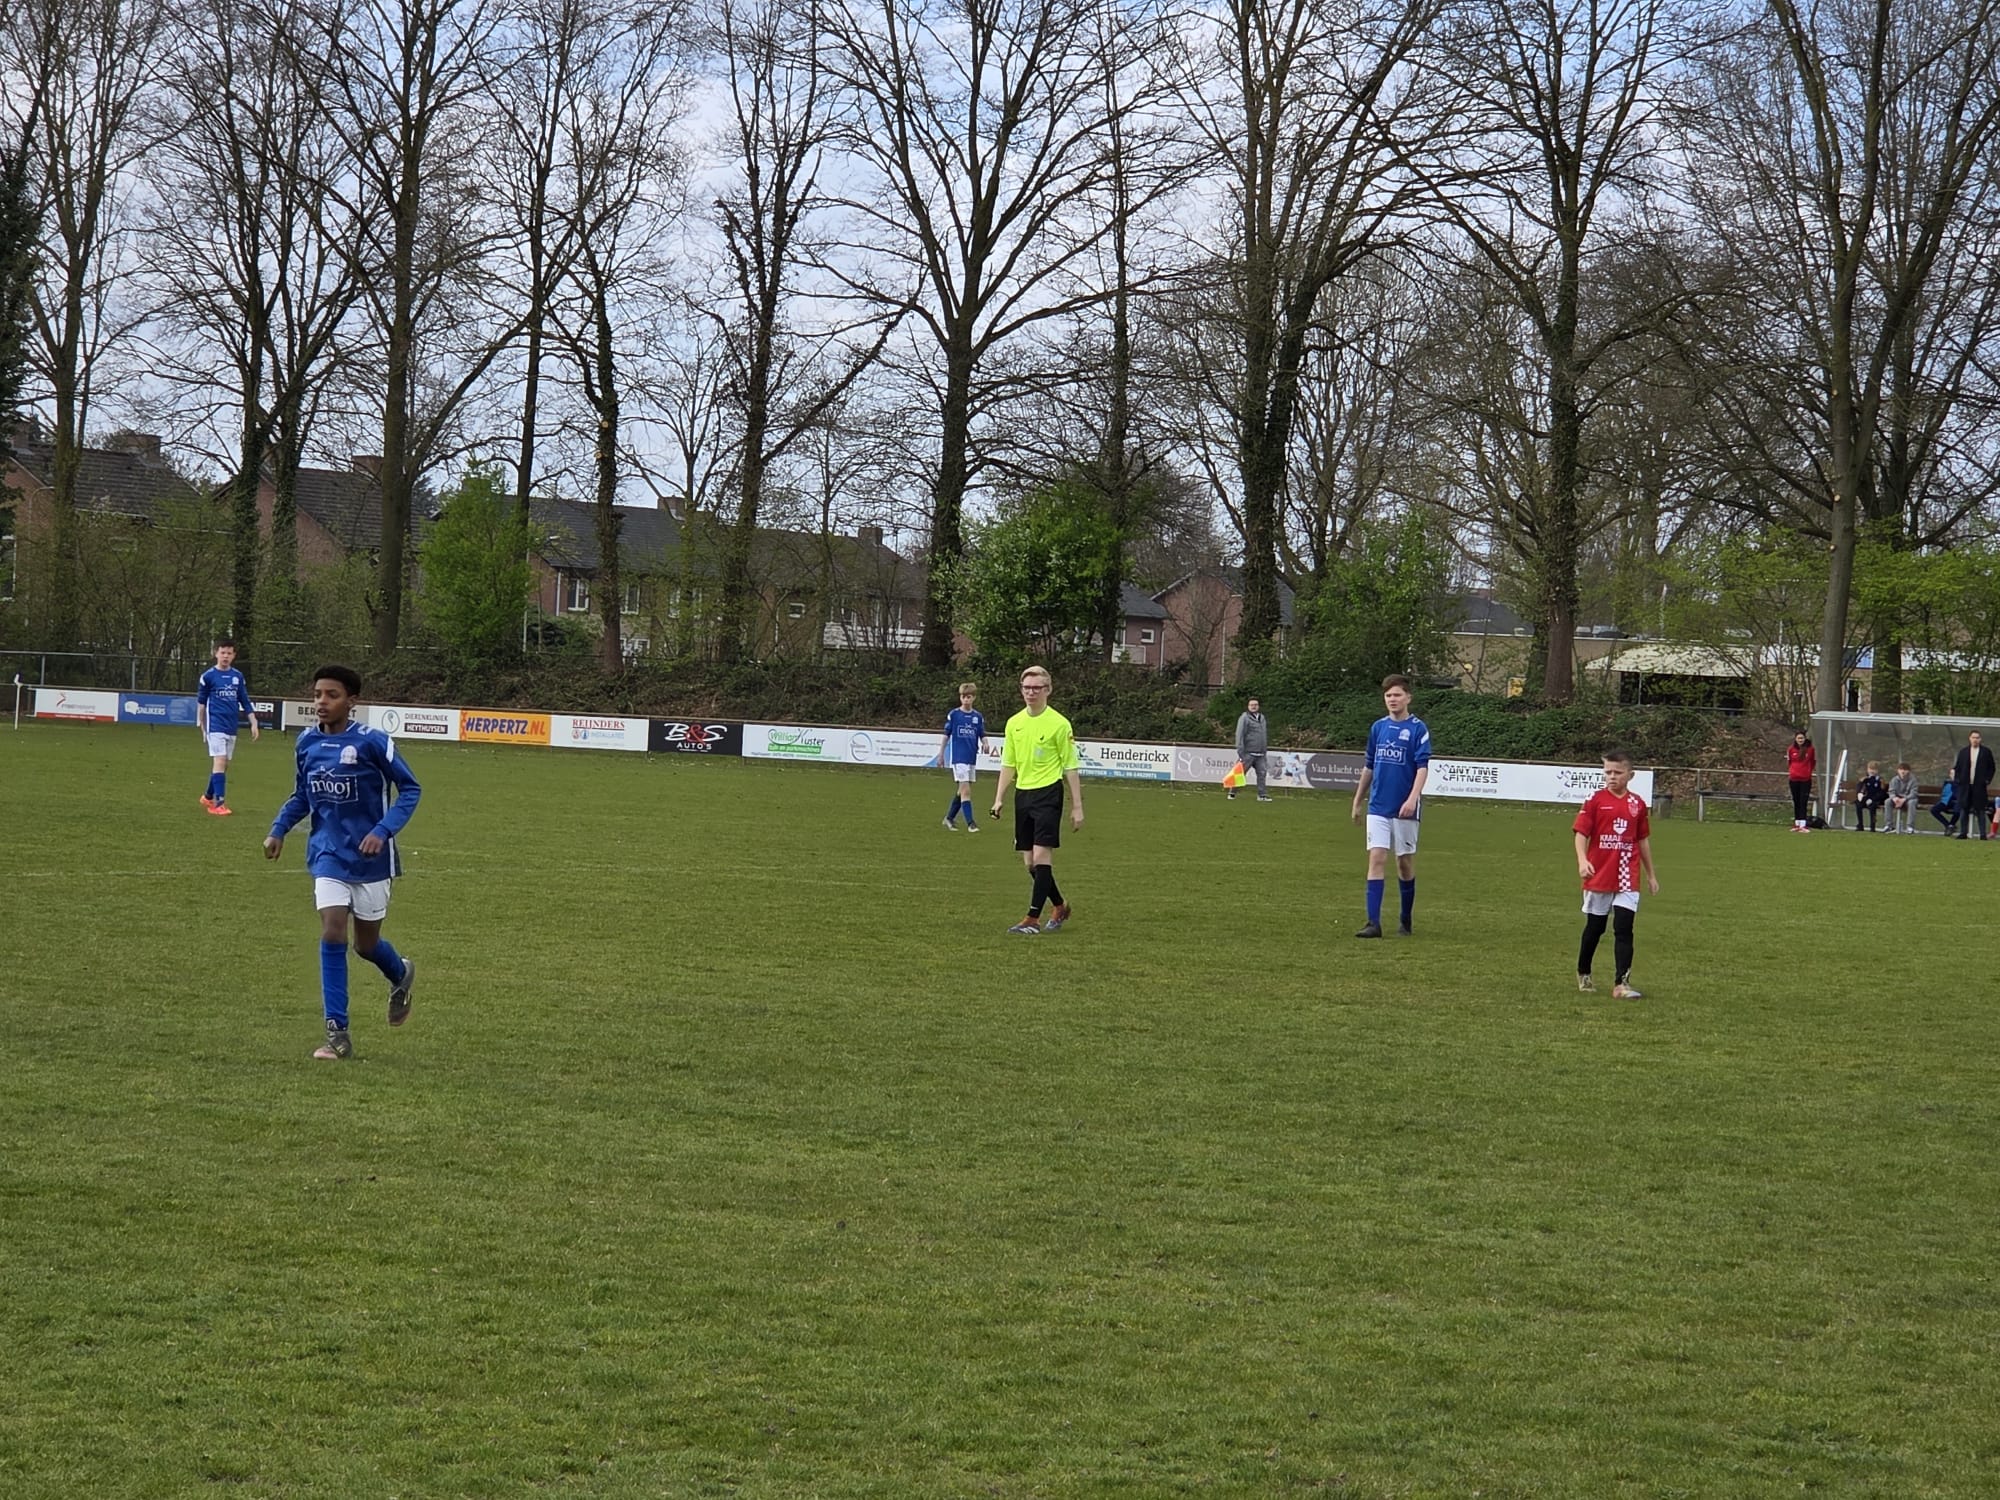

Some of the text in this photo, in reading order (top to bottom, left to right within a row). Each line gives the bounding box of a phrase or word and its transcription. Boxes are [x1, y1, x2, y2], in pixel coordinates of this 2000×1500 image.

[466, 717, 545, 736] HERPERTZ.NL
[572, 719, 625, 729] REIJNDERS
[663, 722, 728, 743] B&S
[676, 742, 712, 750] AUTO'S
[1100, 747, 1170, 762] Henderickx
[1311, 763, 1327, 773] Van
[1328, 764, 1353, 774] klacht
[1448, 765, 1498, 776] ANYTIME
[1448, 775, 1498, 784] FITNESS
[1571, 771, 1606, 782] ANYTI
[310, 777, 351, 799] mooj
[1571, 780, 1606, 789] FITNE
